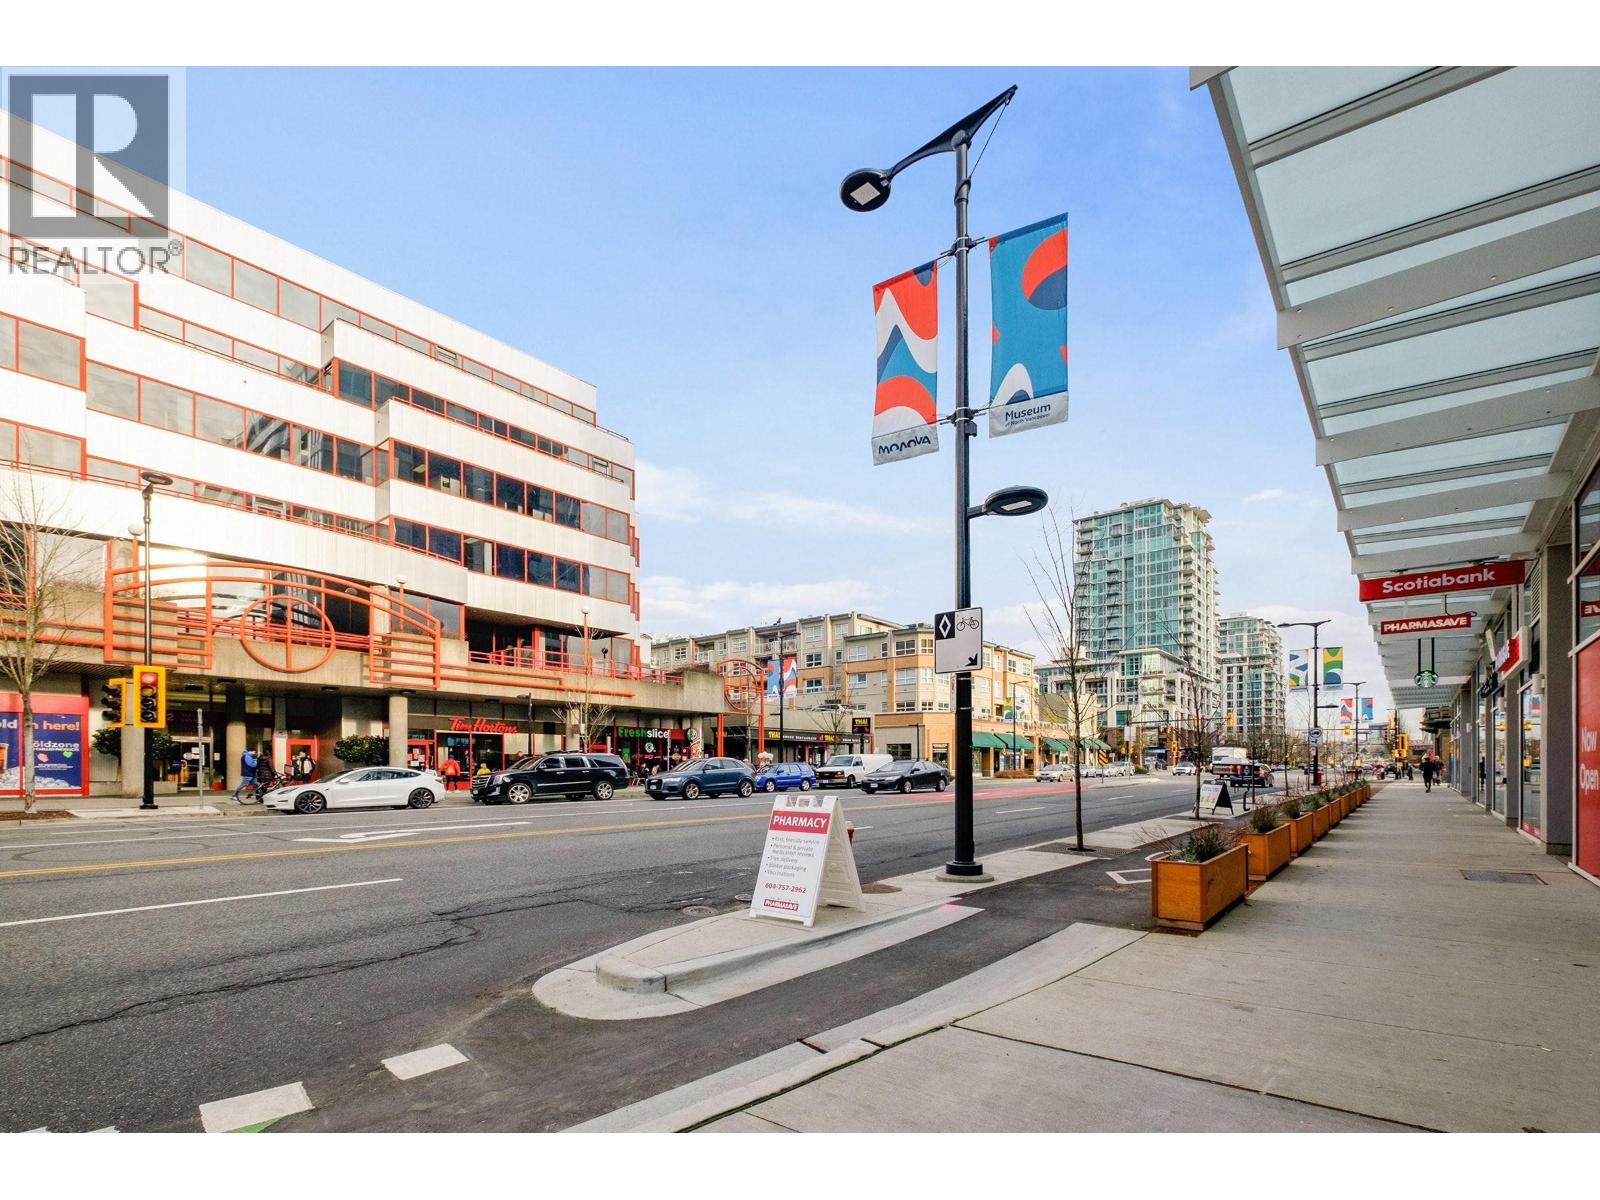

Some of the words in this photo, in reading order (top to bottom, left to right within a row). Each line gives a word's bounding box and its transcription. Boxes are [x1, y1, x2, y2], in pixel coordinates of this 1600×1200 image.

[1005, 404, 1051, 421] Museum
[1382, 568, 1495, 593] Scotiabank
[1383, 616, 1467, 632] PHARMASAVE
[43, 720, 80, 731] here!
[448, 715, 472, 731] Tim
[472, 717, 518, 733] Hortons
[618, 727, 669, 739] Freshslice
[1581, 726, 1597, 753] Now
[1580, 763, 1599, 795] Open
[772, 815, 828, 828] PHARMACY
[765, 883, 806, 893] 604-757-2962
